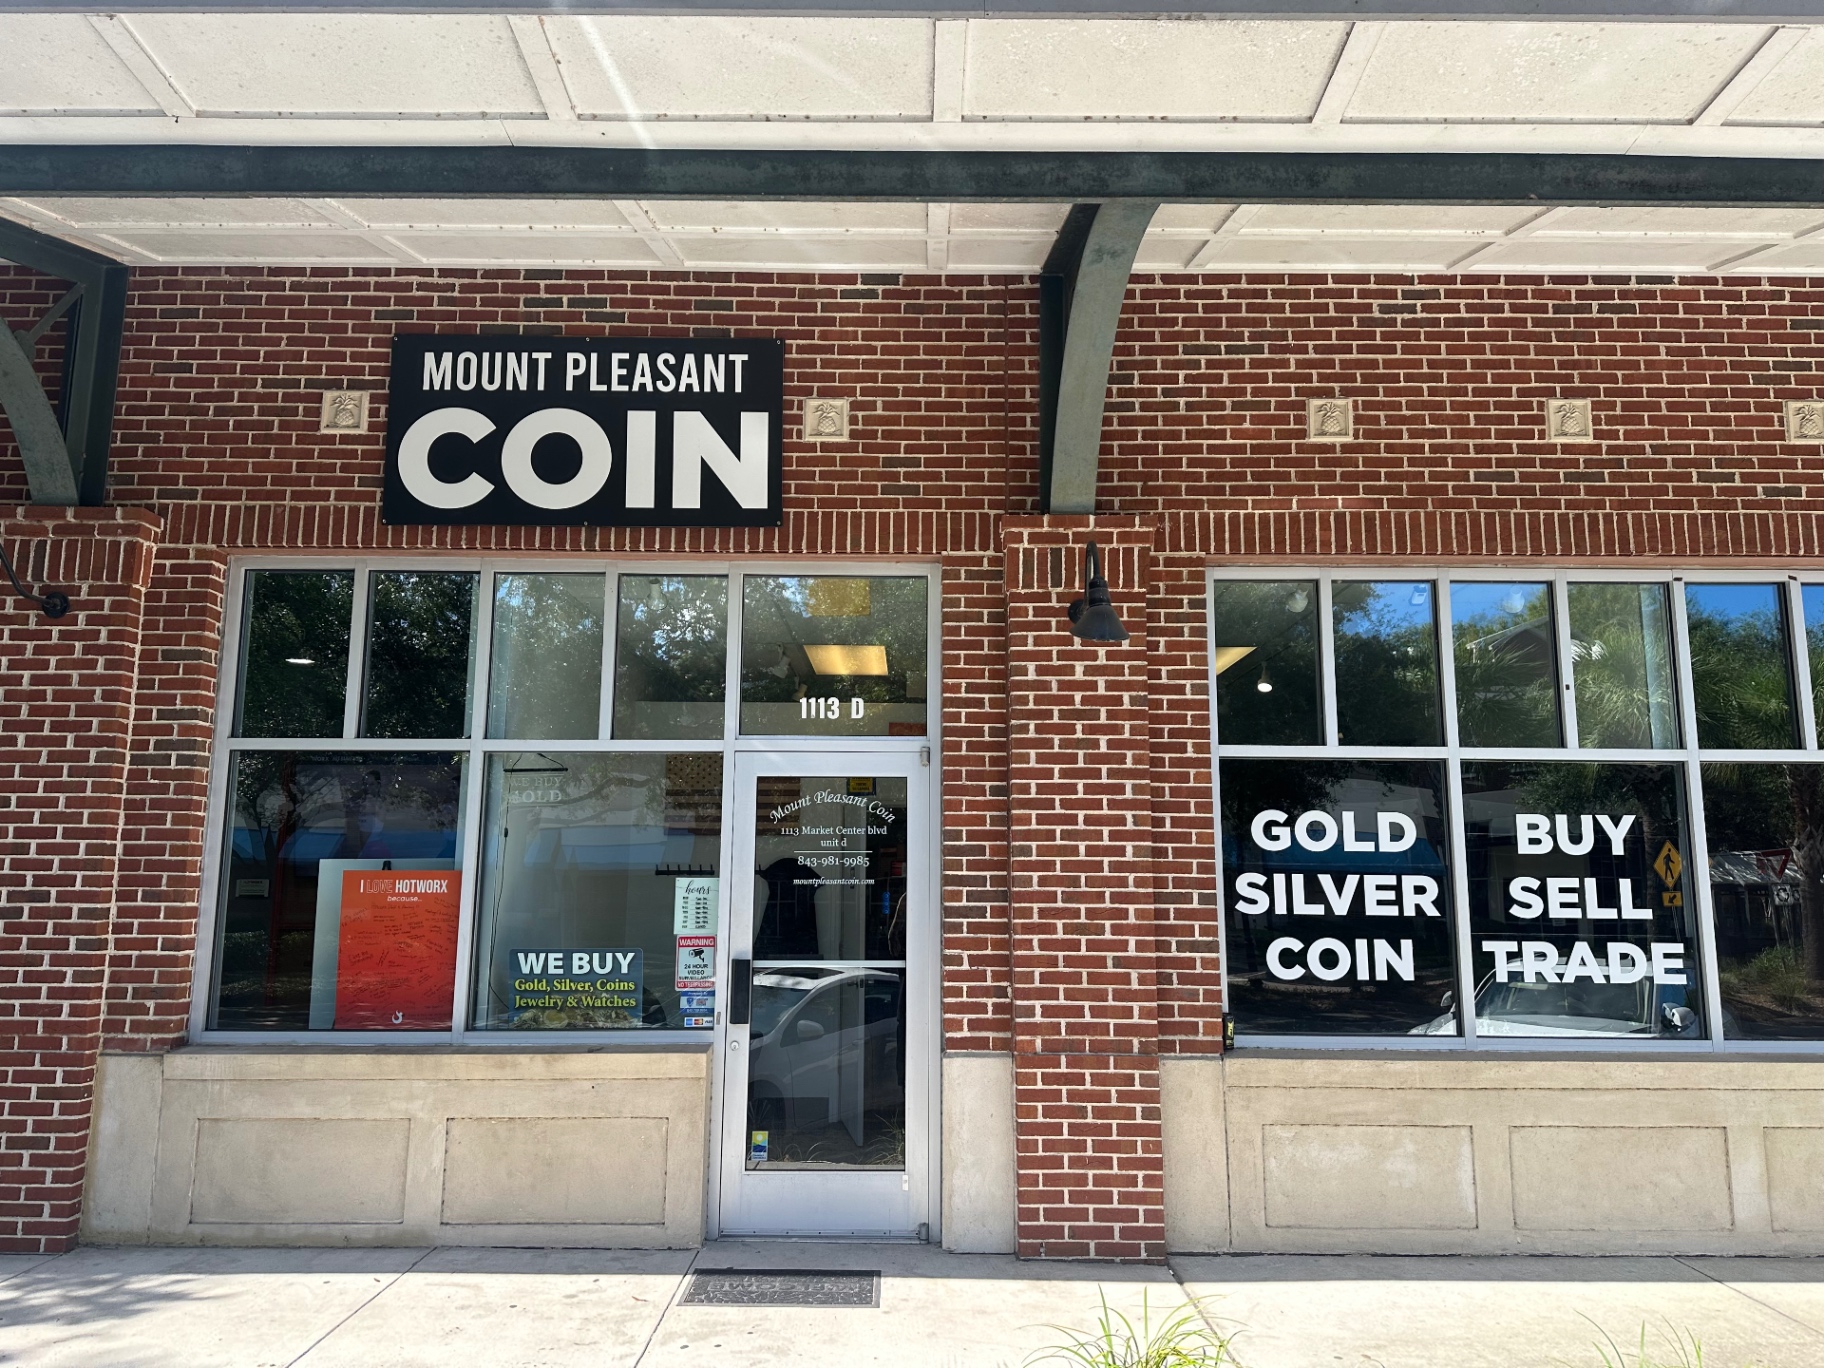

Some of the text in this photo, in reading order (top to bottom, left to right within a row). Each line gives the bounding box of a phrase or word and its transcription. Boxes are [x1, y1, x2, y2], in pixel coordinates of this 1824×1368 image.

[423, 352, 749, 393] MOUNT PLEASANT
[398, 407, 769, 510] COIN
[799, 697, 865, 720] 1113 D
[534, 776, 564, 787] BUY
[769, 788, 896, 824] Mount Pleasant Coin
[780, 825, 888, 837] 1113 Market Center blvd
[820, 837, 848, 847] unit d
[1251, 809, 1417, 853] GOLD
[1516, 813, 1637, 856] BUY
[797, 855, 870, 868] 843-981-9985
[360, 879, 449, 894] I LOVE HOTWORX
[684, 879, 711, 895] hours
[793, 876, 875, 887] mountpleasantcoin.com
[1234, 873, 1442, 917] SILVER
[1508, 876, 1654, 920] SELL
[679, 938, 714, 947] WARNING
[517, 952, 636, 975] WE BUY
[1265, 936, 1415, 981] COIN
[1481, 940, 1688, 984] TRADE
[514, 978, 636, 993] Gold, Silver, Coins
[514, 995, 637, 1010] Jewelry & Watches
